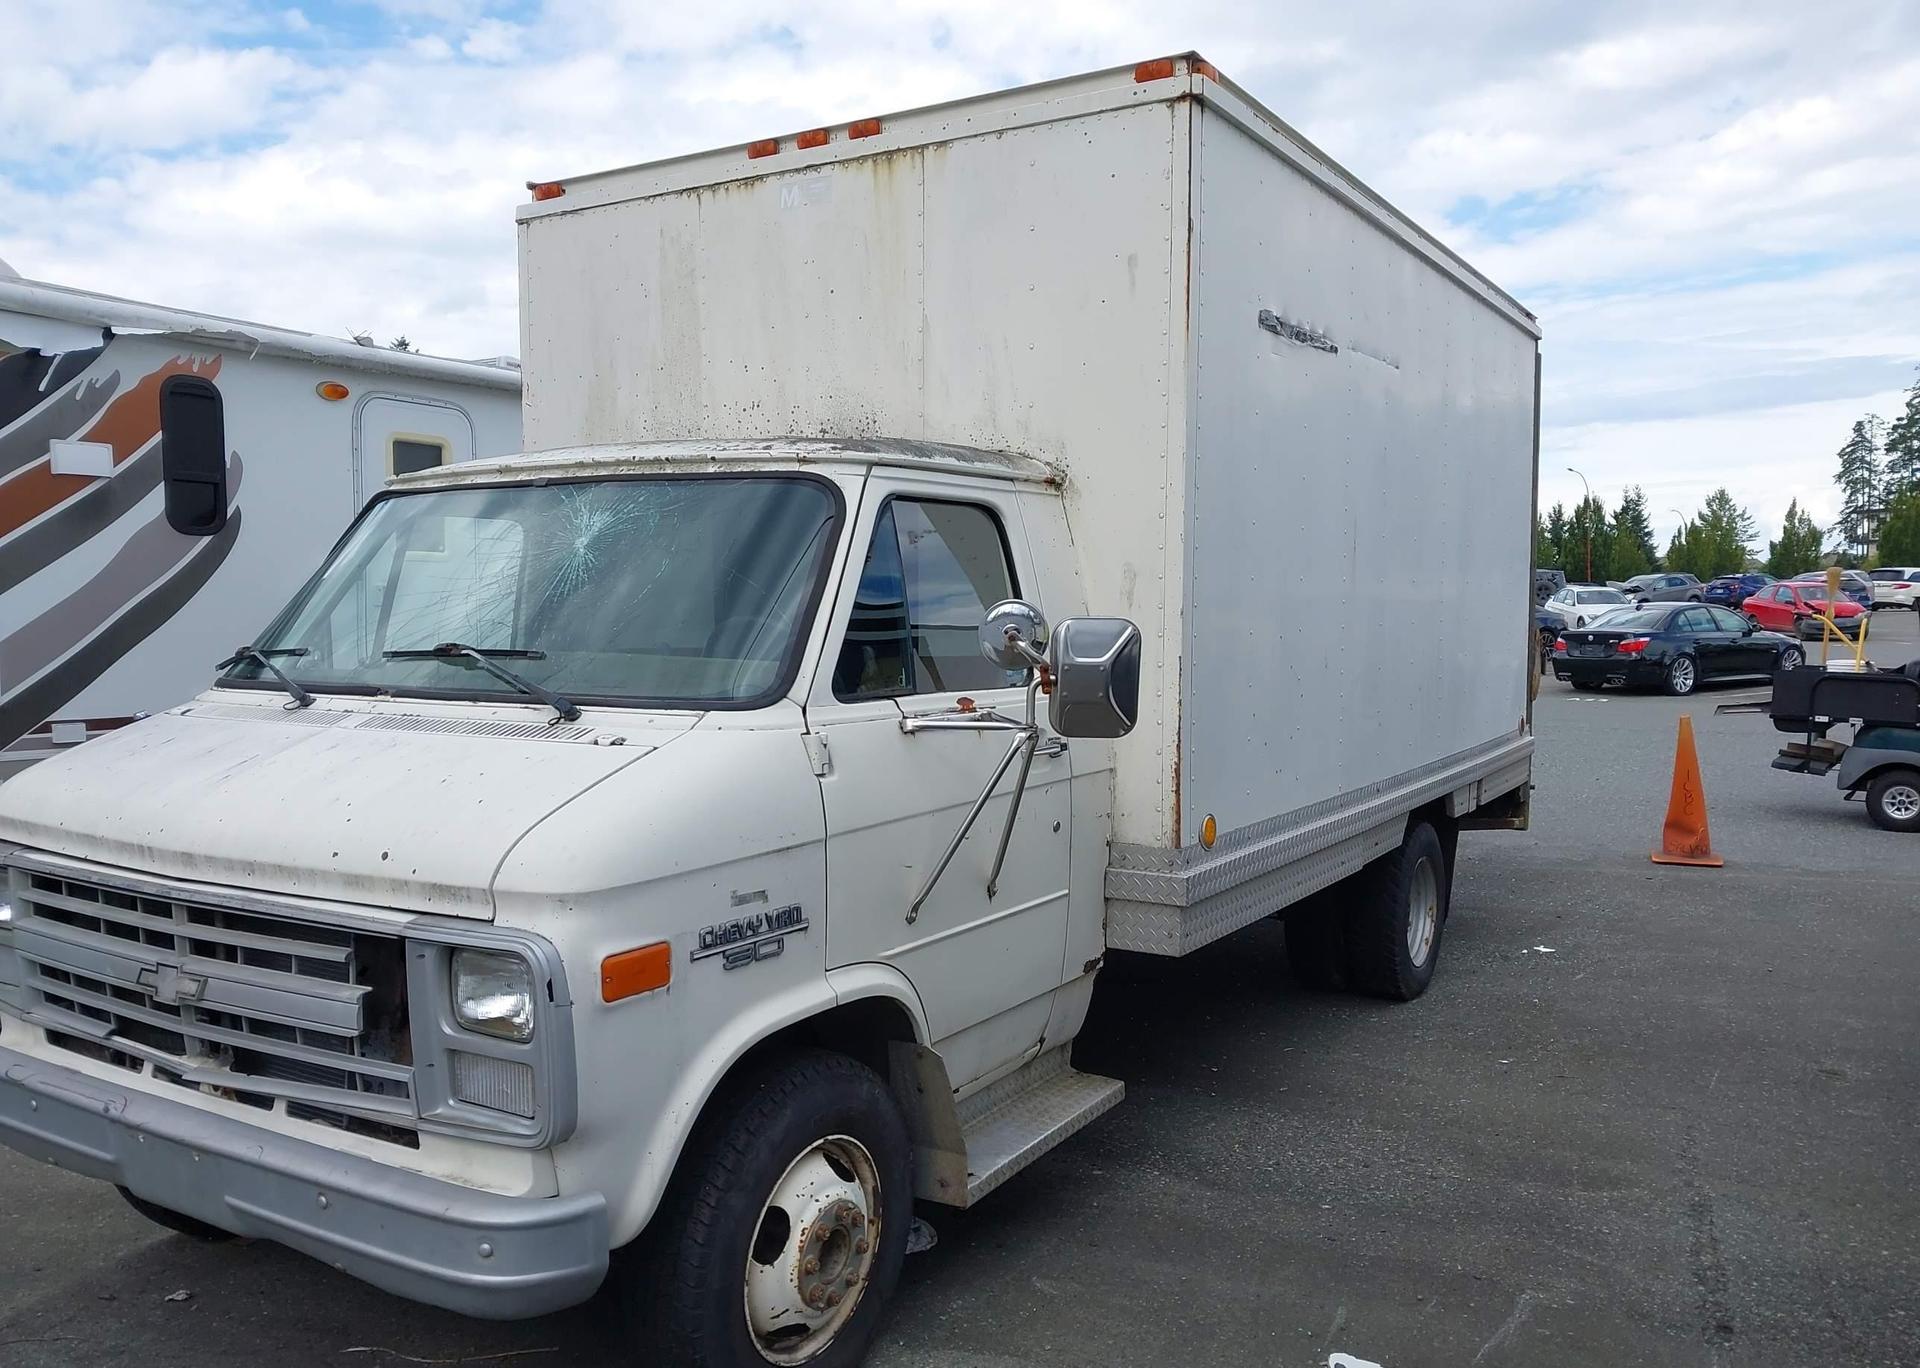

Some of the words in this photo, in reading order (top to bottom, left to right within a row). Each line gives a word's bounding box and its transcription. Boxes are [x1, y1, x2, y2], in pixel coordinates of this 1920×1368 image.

[698, 913, 764, 949] CHEVY
[764, 903, 803, 931] VAN
[722, 938, 785, 971] 30
